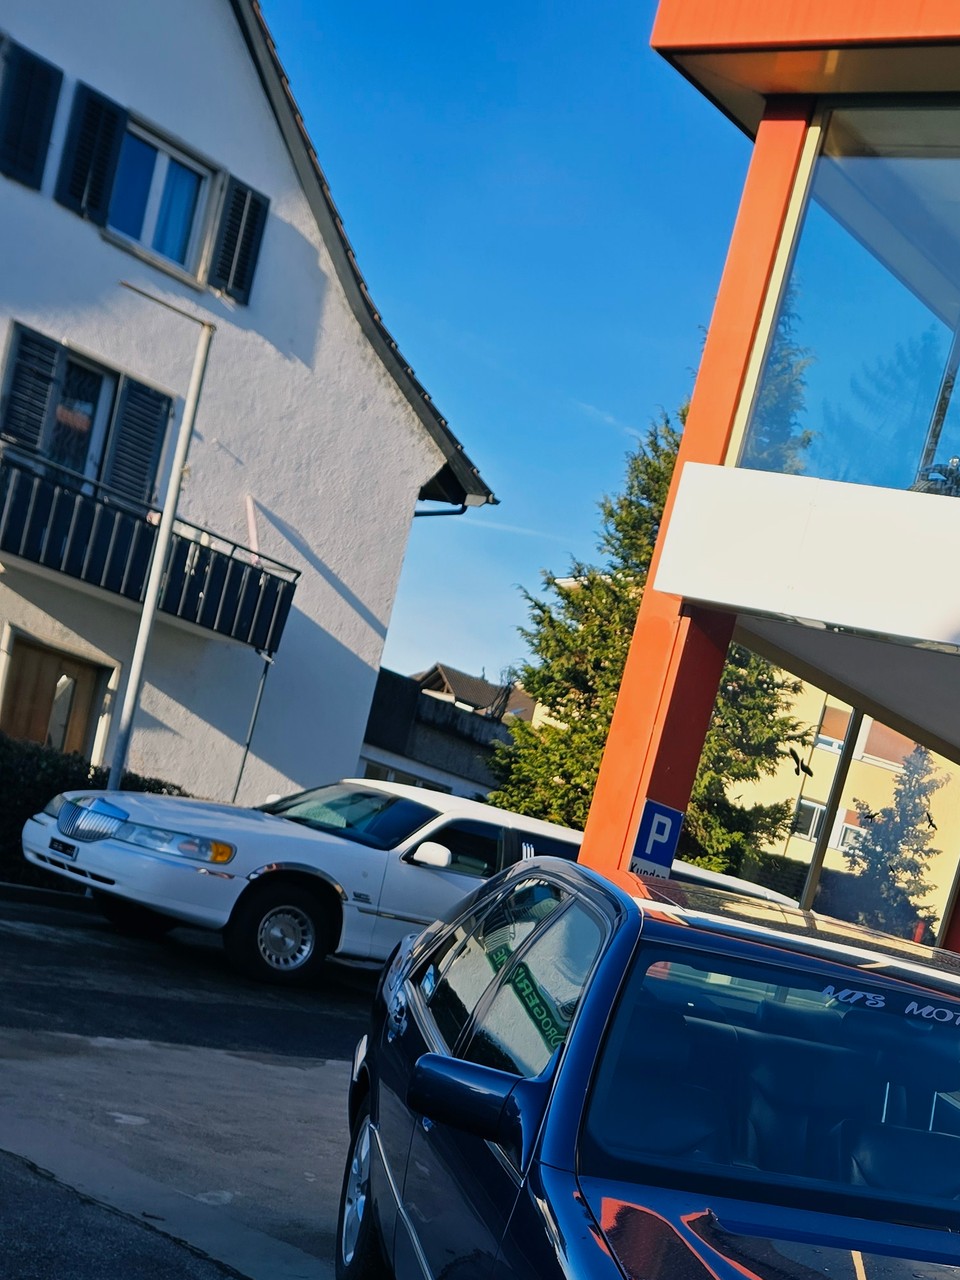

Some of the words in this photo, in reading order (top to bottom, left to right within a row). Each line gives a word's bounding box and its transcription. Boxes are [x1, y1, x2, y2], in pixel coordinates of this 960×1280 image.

[645, 812, 673, 855] P
[630, 862, 667, 880] Kund
[821, 984, 886, 1009] MTS
